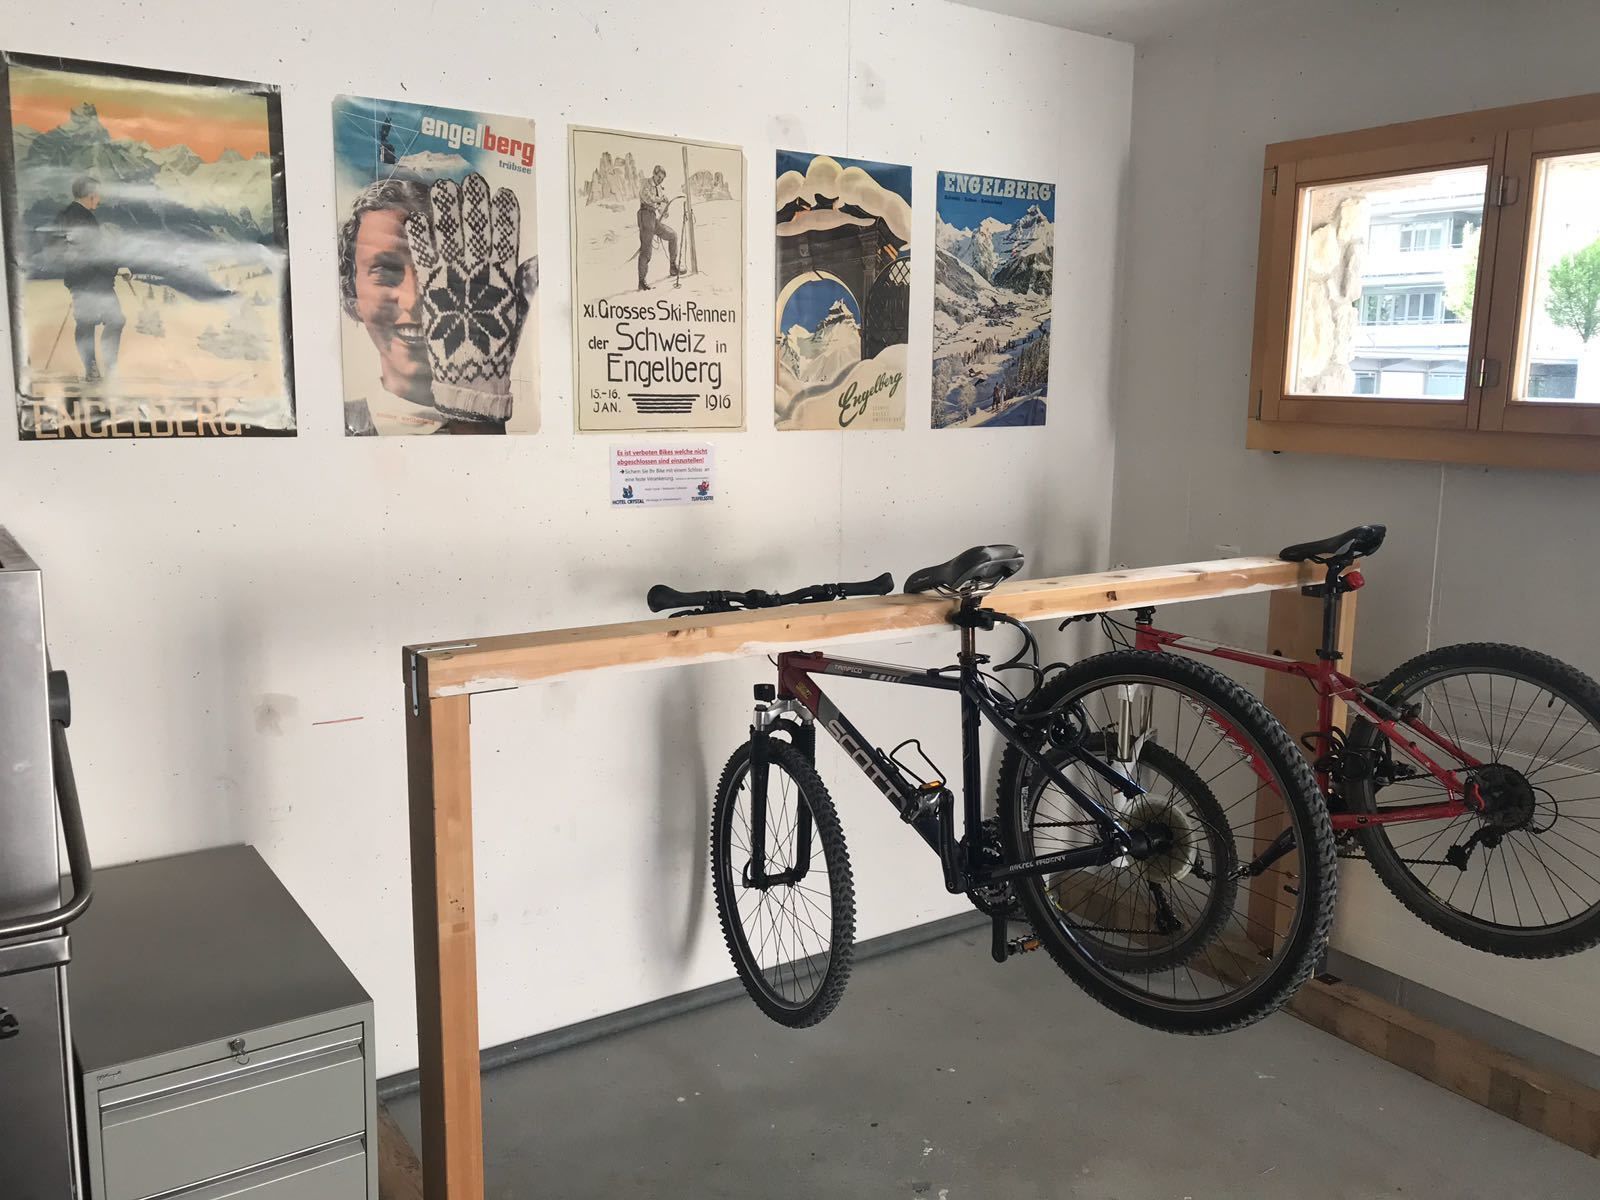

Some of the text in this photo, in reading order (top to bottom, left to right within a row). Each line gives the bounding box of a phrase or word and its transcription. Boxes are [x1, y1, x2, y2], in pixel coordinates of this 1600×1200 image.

[421, 116, 535, 167] engelberg
[498, 160, 532, 175] trübsee
[944, 173, 1052, 201] ENGELBERG
[598, 299, 656, 320] Grosses
[656, 300, 736, 323] Ski-Rennen
[588, 322, 727, 353] der Schweiz in
[607, 353, 722, 389] Engelberg
[592, 402, 622, 413] JAN.
[705, 394, 731, 410] 1916
[838, 371, 903, 428] Engelberg
[827, 719, 902, 799] SCOTT
